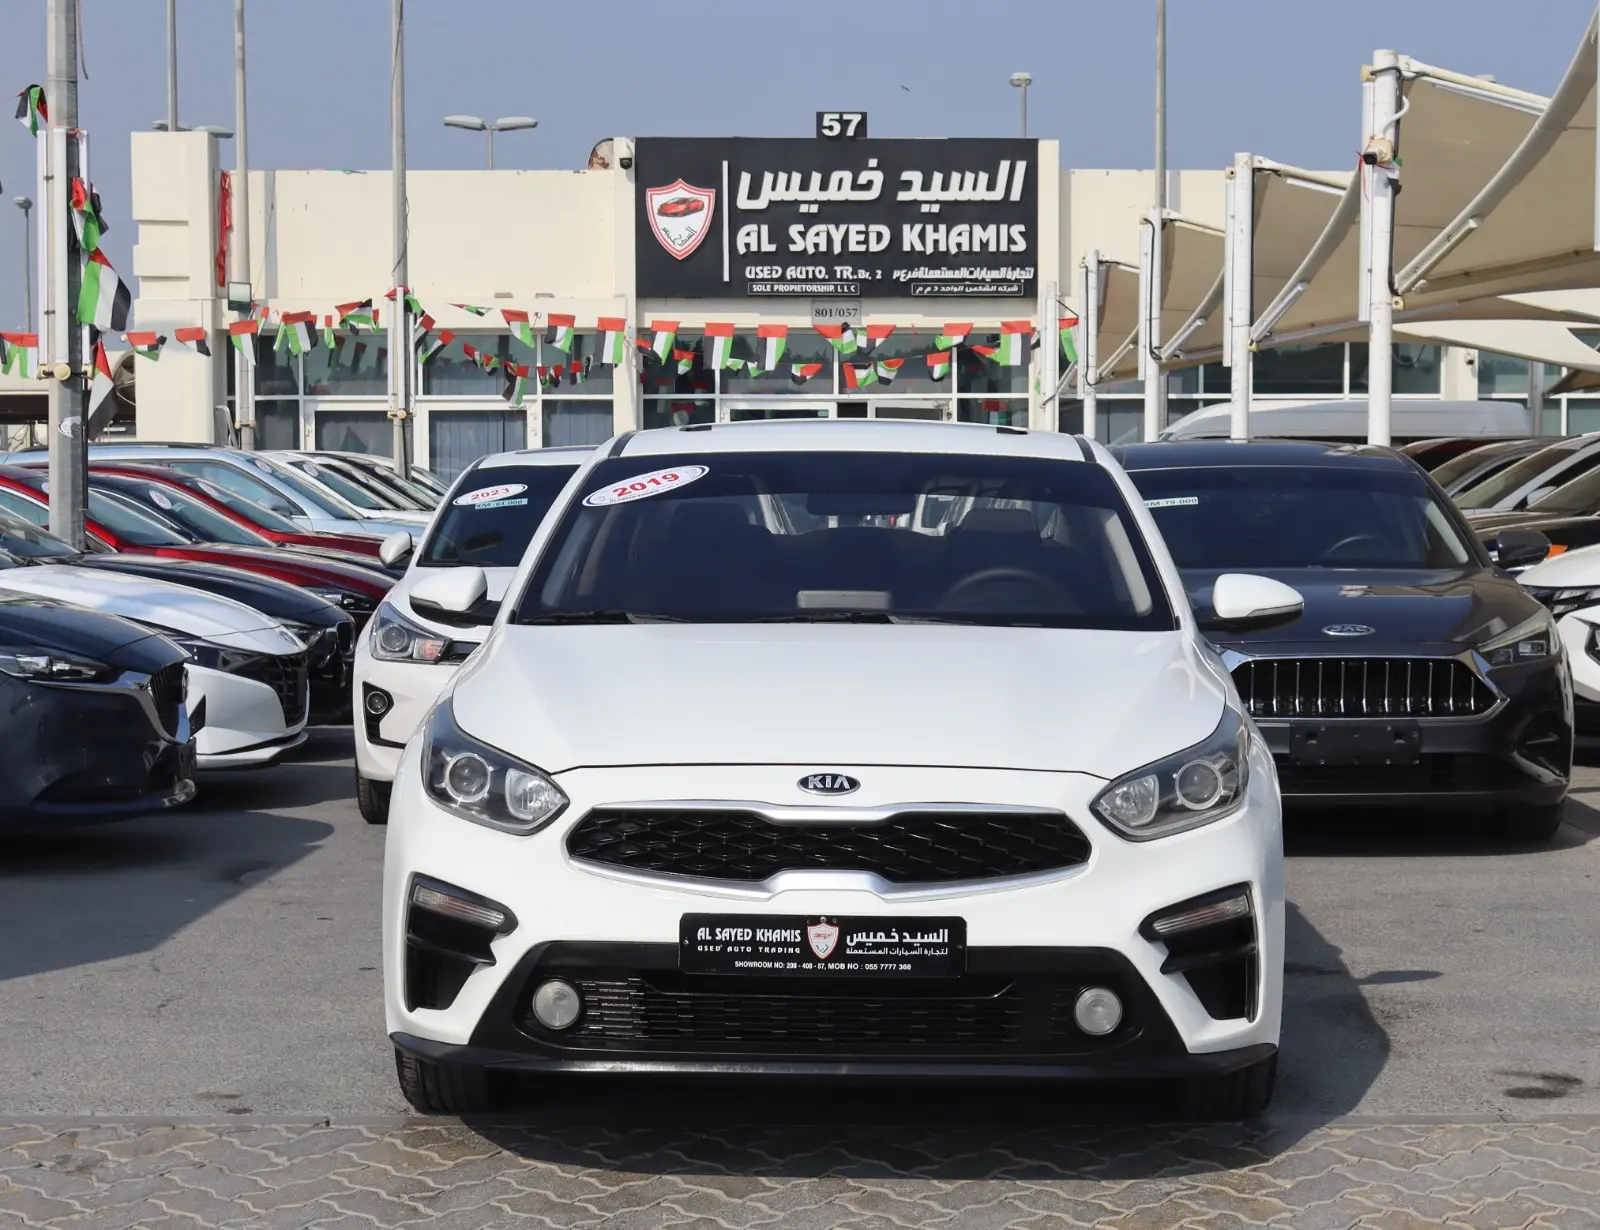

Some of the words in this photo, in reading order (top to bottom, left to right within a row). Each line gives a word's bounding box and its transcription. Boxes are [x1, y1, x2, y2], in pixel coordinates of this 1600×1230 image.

[821, 113, 862, 137] 57
[736, 158, 884, 213] خميس
[897, 160, 1027, 213] السيد
[736, 224, 777, 255] AL
[788, 224, 891, 256] SAYED
[902, 224, 1027, 256] KHAMIS
[745, 265, 782, 279] USED
[786, 265, 829, 280] AUTO.
[875, 269, 883, 279] 2
[752, 284, 771, 293] SOLE
[814, 308, 859, 318] 801/057
[612, 473, 680, 496] 2019
[471, 487, 511, 500] 2023
[808, 775, 851, 789] KIA
[697, 928, 712, 941] AL
[715, 928, 753, 942] SAYED
[756, 928, 802, 943] KHAMIS
[846, 928, 900, 947] خميس
[902, 929, 949, 947] السيد
[758, 946, 801, 954] TRADING
[846, 948, 888, 956] المستعملة
[889, 947, 923, 957] السيارات
[924, 948, 948, 957] لتجارة
[734, 961, 773, 969] SHOWROOM
[879, 963, 897, 971] 7777
